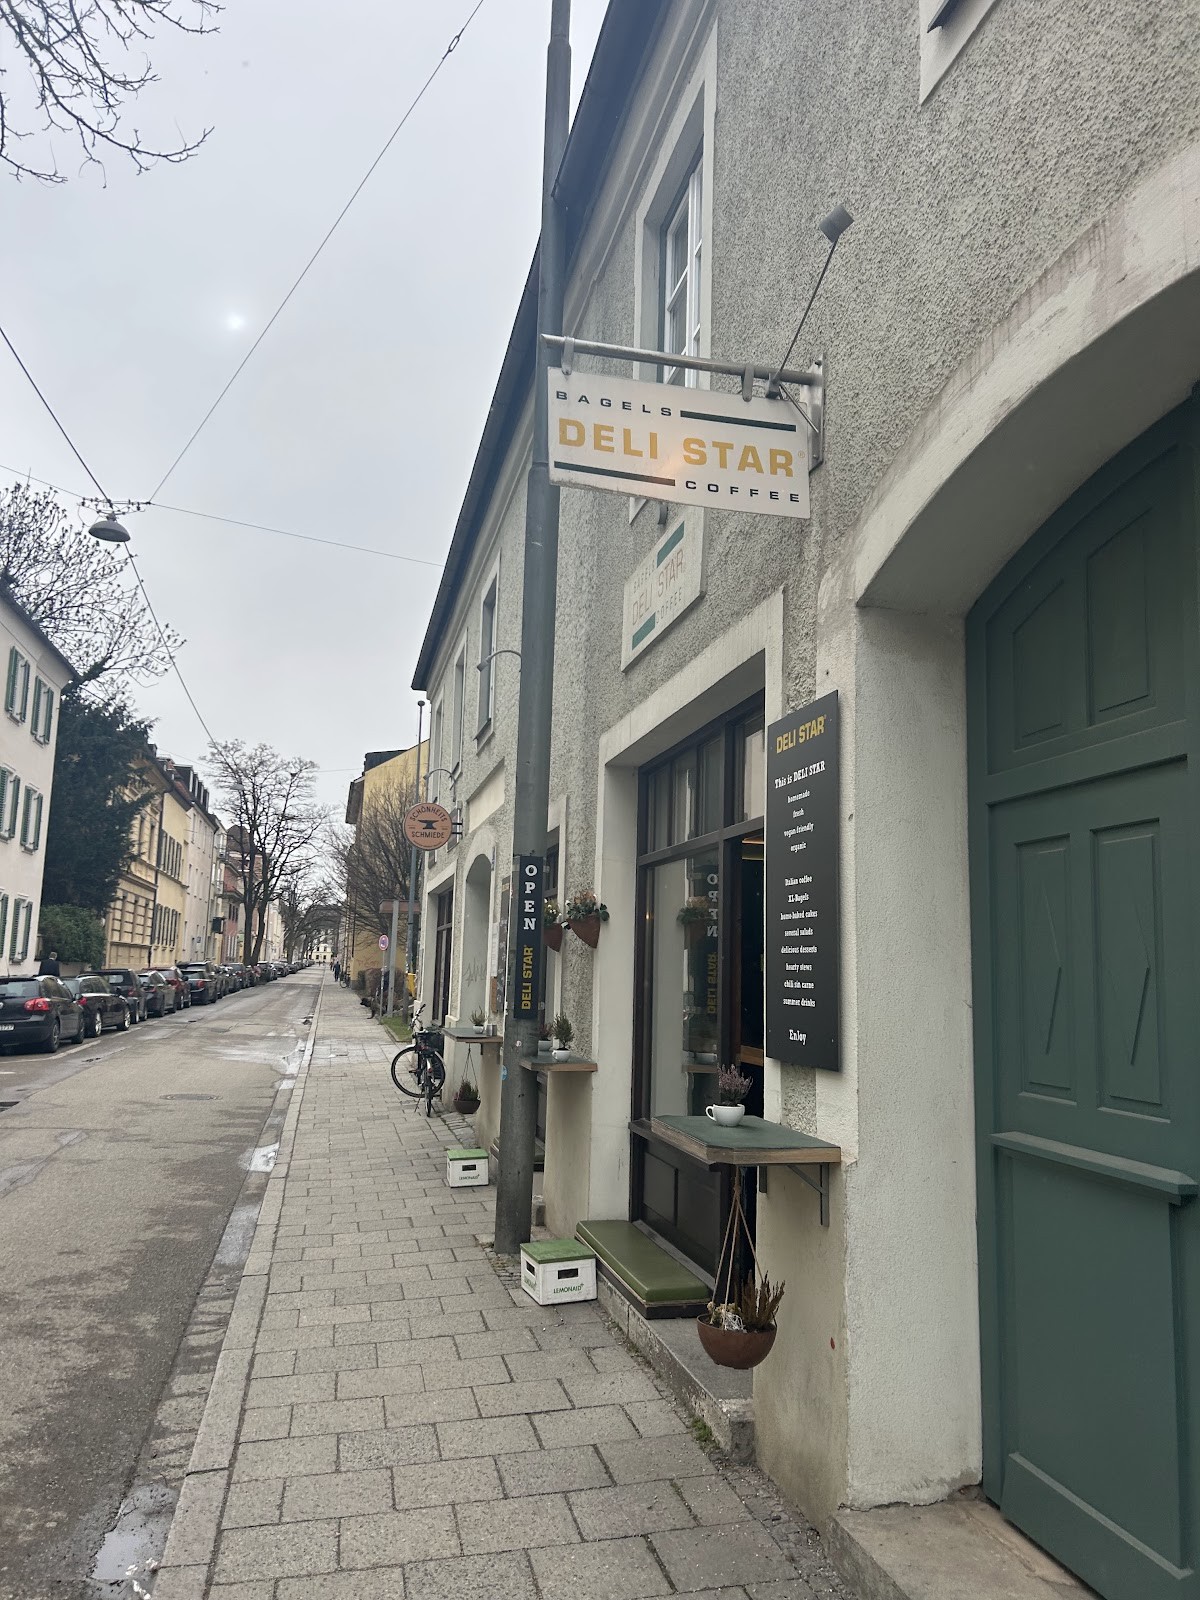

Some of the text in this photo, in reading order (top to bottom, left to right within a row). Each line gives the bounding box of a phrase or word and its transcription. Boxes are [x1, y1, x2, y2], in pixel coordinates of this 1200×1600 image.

[556, 390, 672, 417] BAGELS
[558, 417, 658, 460] DELI
[685, 480, 800, 503] COFFEE
[632, 548, 684, 626] DELI STAR
[656, 586, 682, 624] COFFEE
[776, 715, 826, 754] DELI STAR
[774, 760, 826, 789] This is DELI STAR
[787, 789, 811, 804] homemade
[409, 805, 448, 822] SCHÖNHEITS
[411, 830, 445, 839] SCHMIEDE
[790, 841, 807, 853] organic
[784, 874, 813, 886] Italian coffee
[523, 864, 538, 931] OPEN
[805, 909, 818, 918] cakes
[784, 927, 814, 937] several salads
[781, 945, 818, 954] delicious desserts
[785, 962, 813, 973] hearty stews
[521, 947, 534, 1010] DELI STAR
[783, 979, 794, 988] chili
[783, 998, 816, 1007] summer drinks
